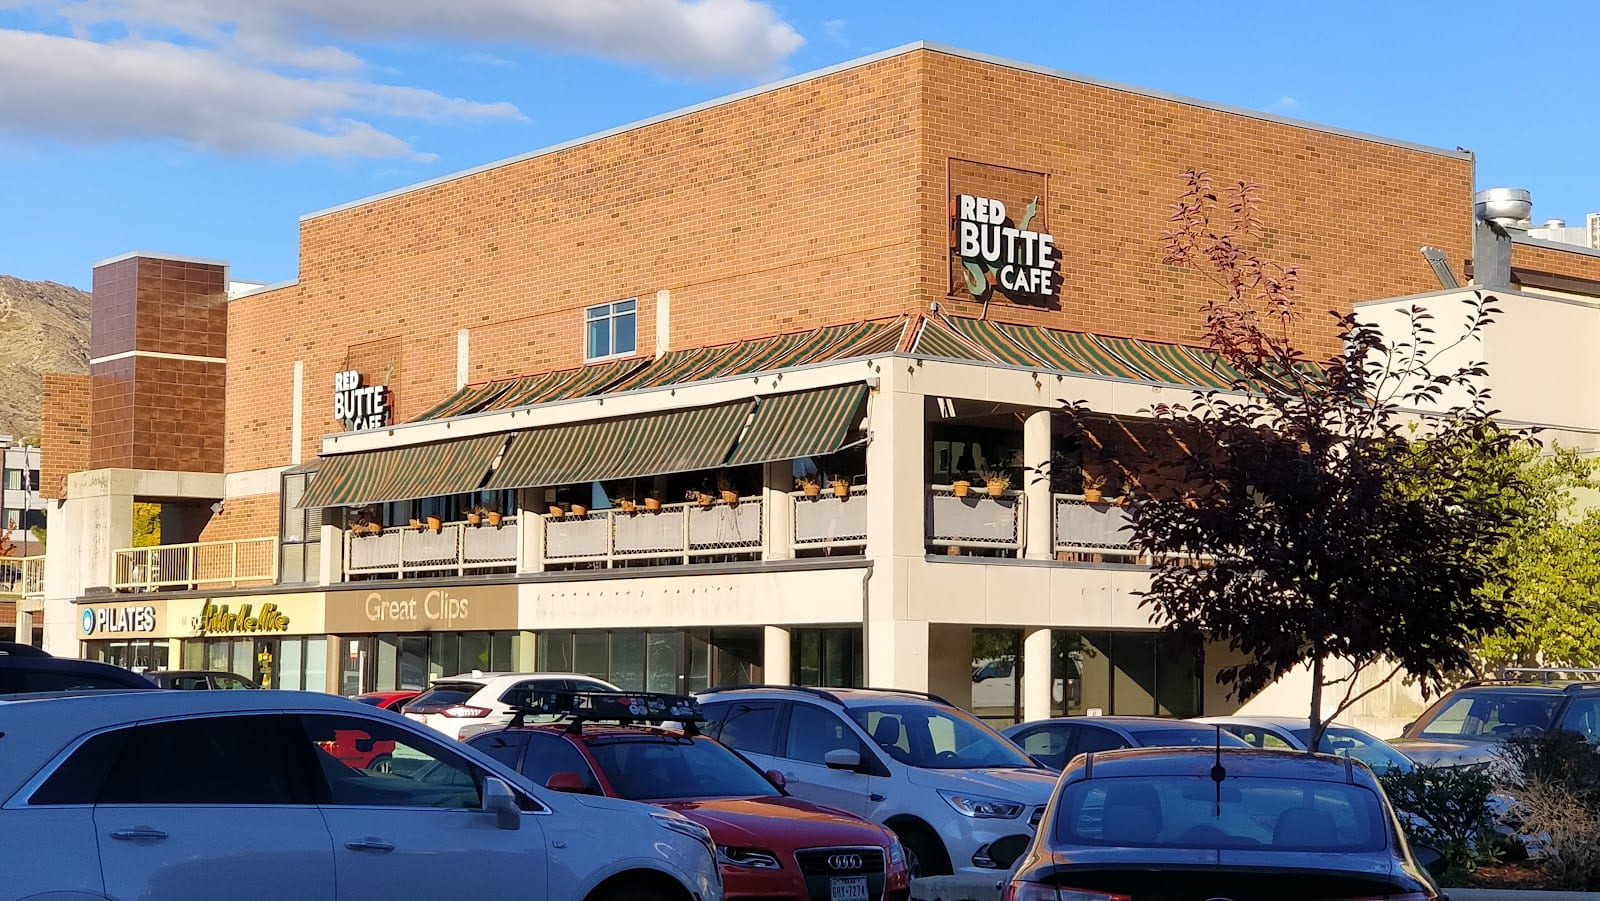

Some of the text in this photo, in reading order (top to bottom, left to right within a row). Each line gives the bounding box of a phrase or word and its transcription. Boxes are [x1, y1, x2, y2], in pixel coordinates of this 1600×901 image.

[960, 194, 1006, 225] RED
[960, 221, 1056, 269] BUTTE
[1000, 264, 1053, 295] CAFE
[335, 370, 359, 391] RED
[335, 385, 384, 419] BUTTE
[353, 414, 382, 432] CAFE
[97, 606, 155, 633] PILATES
[365, 590, 469, 628] Great Clips
